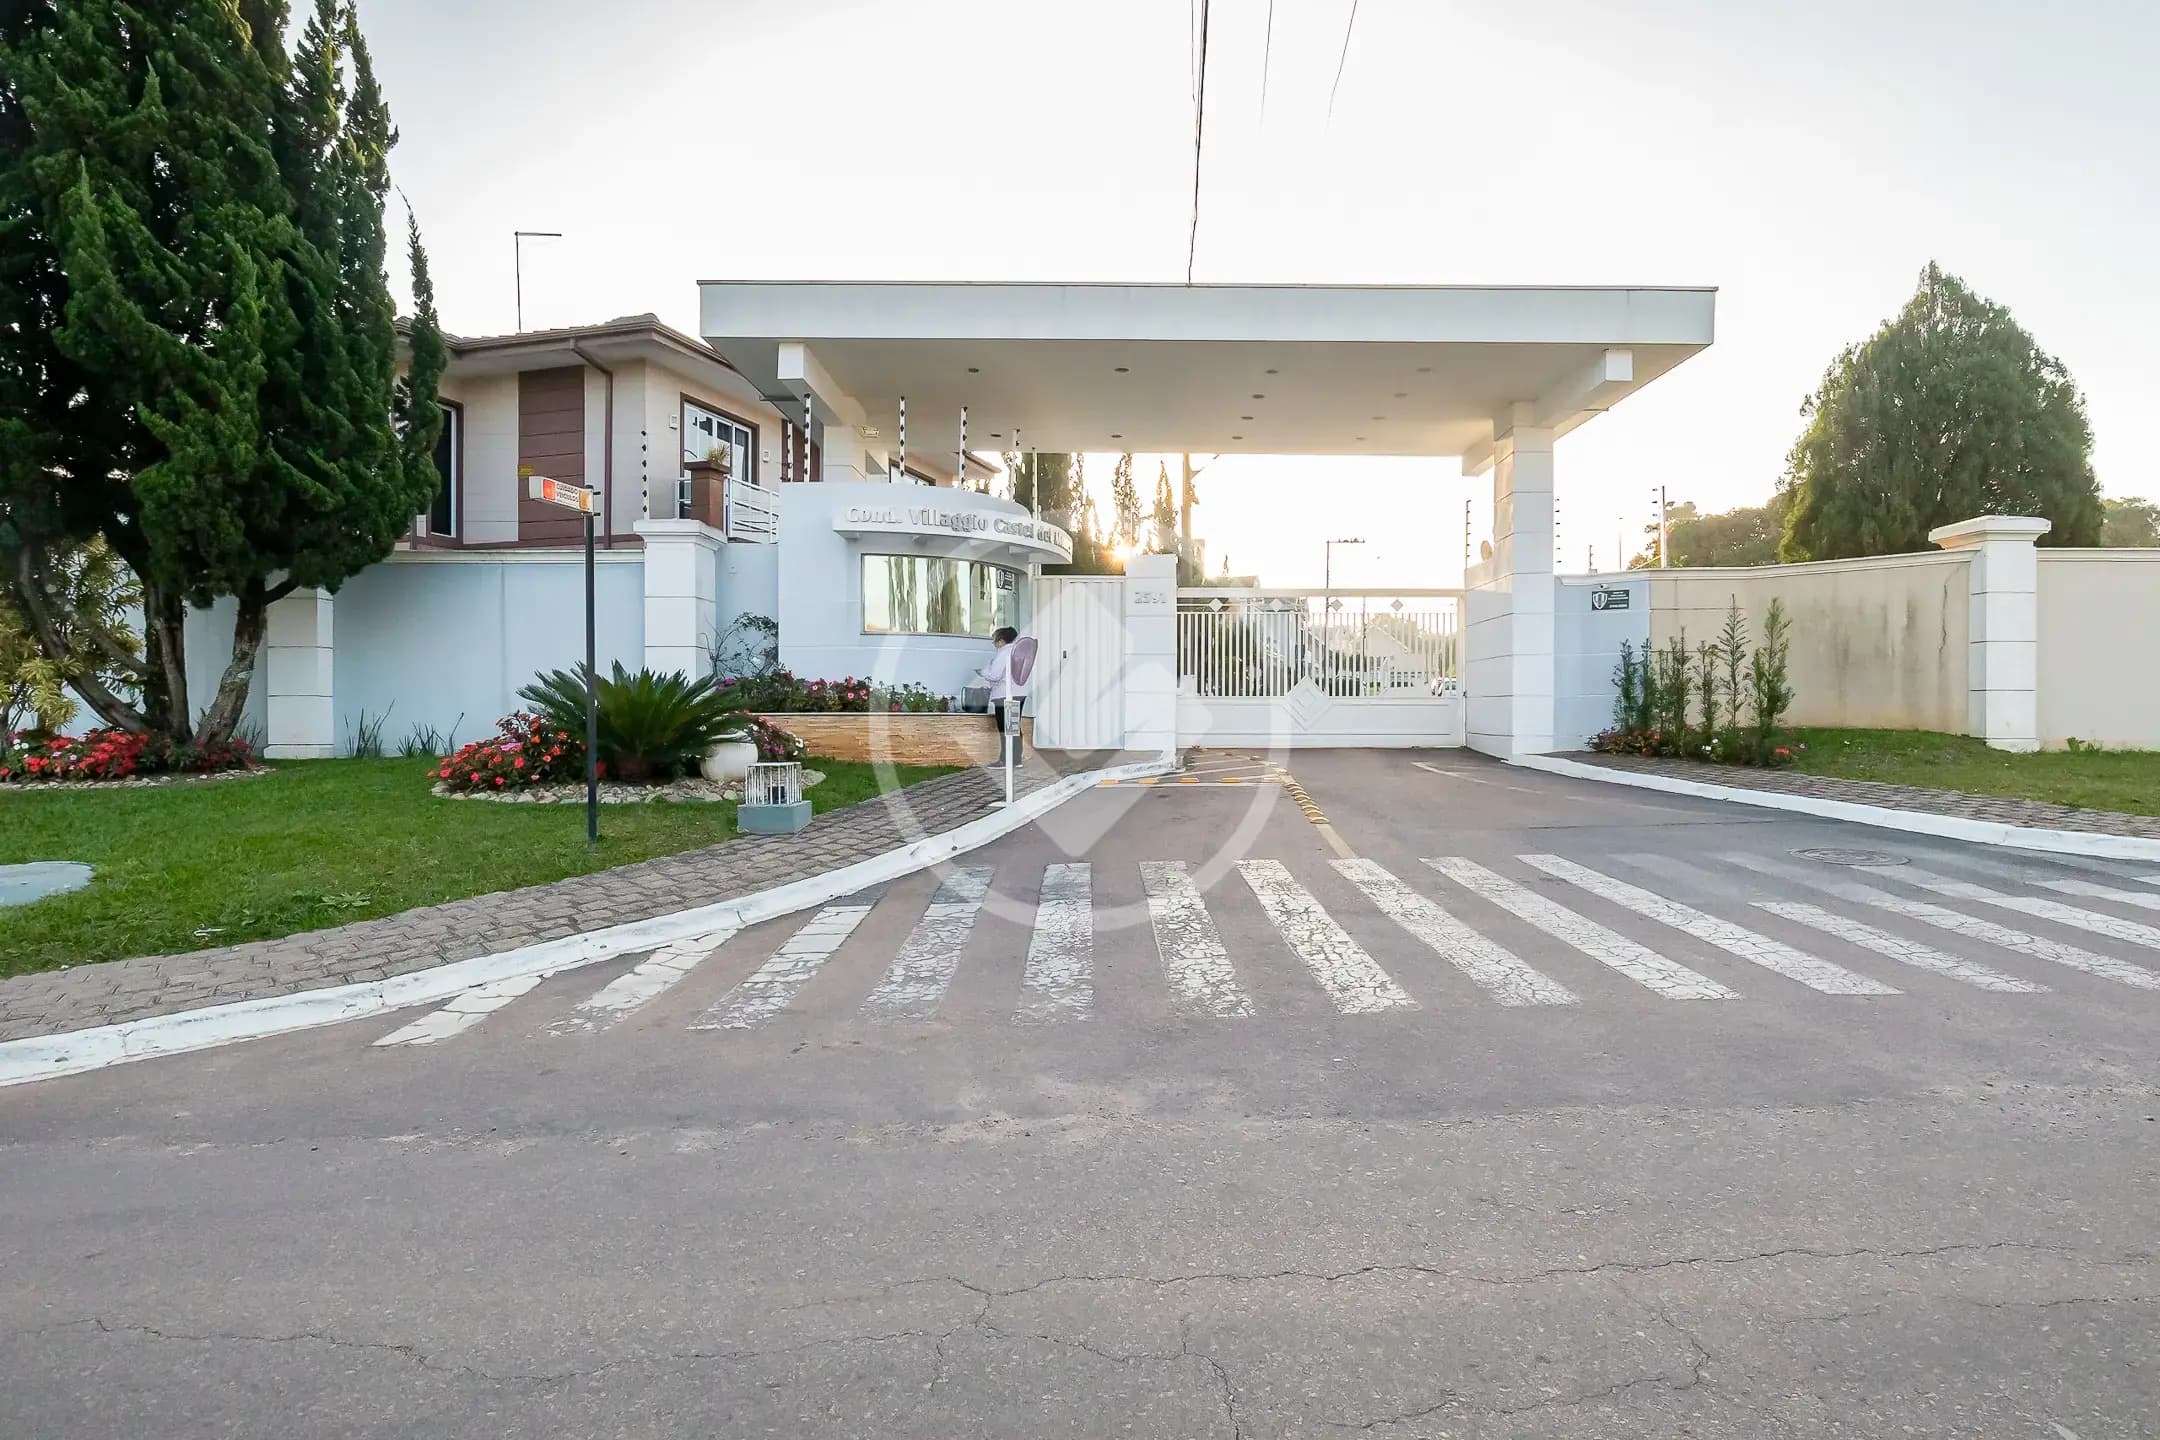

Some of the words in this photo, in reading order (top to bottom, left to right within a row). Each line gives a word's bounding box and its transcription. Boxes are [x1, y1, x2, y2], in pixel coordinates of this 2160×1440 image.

[847, 507, 903, 523] Cond.
[908, 508, 988, 532] Villaggio
[993, 518, 1035, 539] Castel
